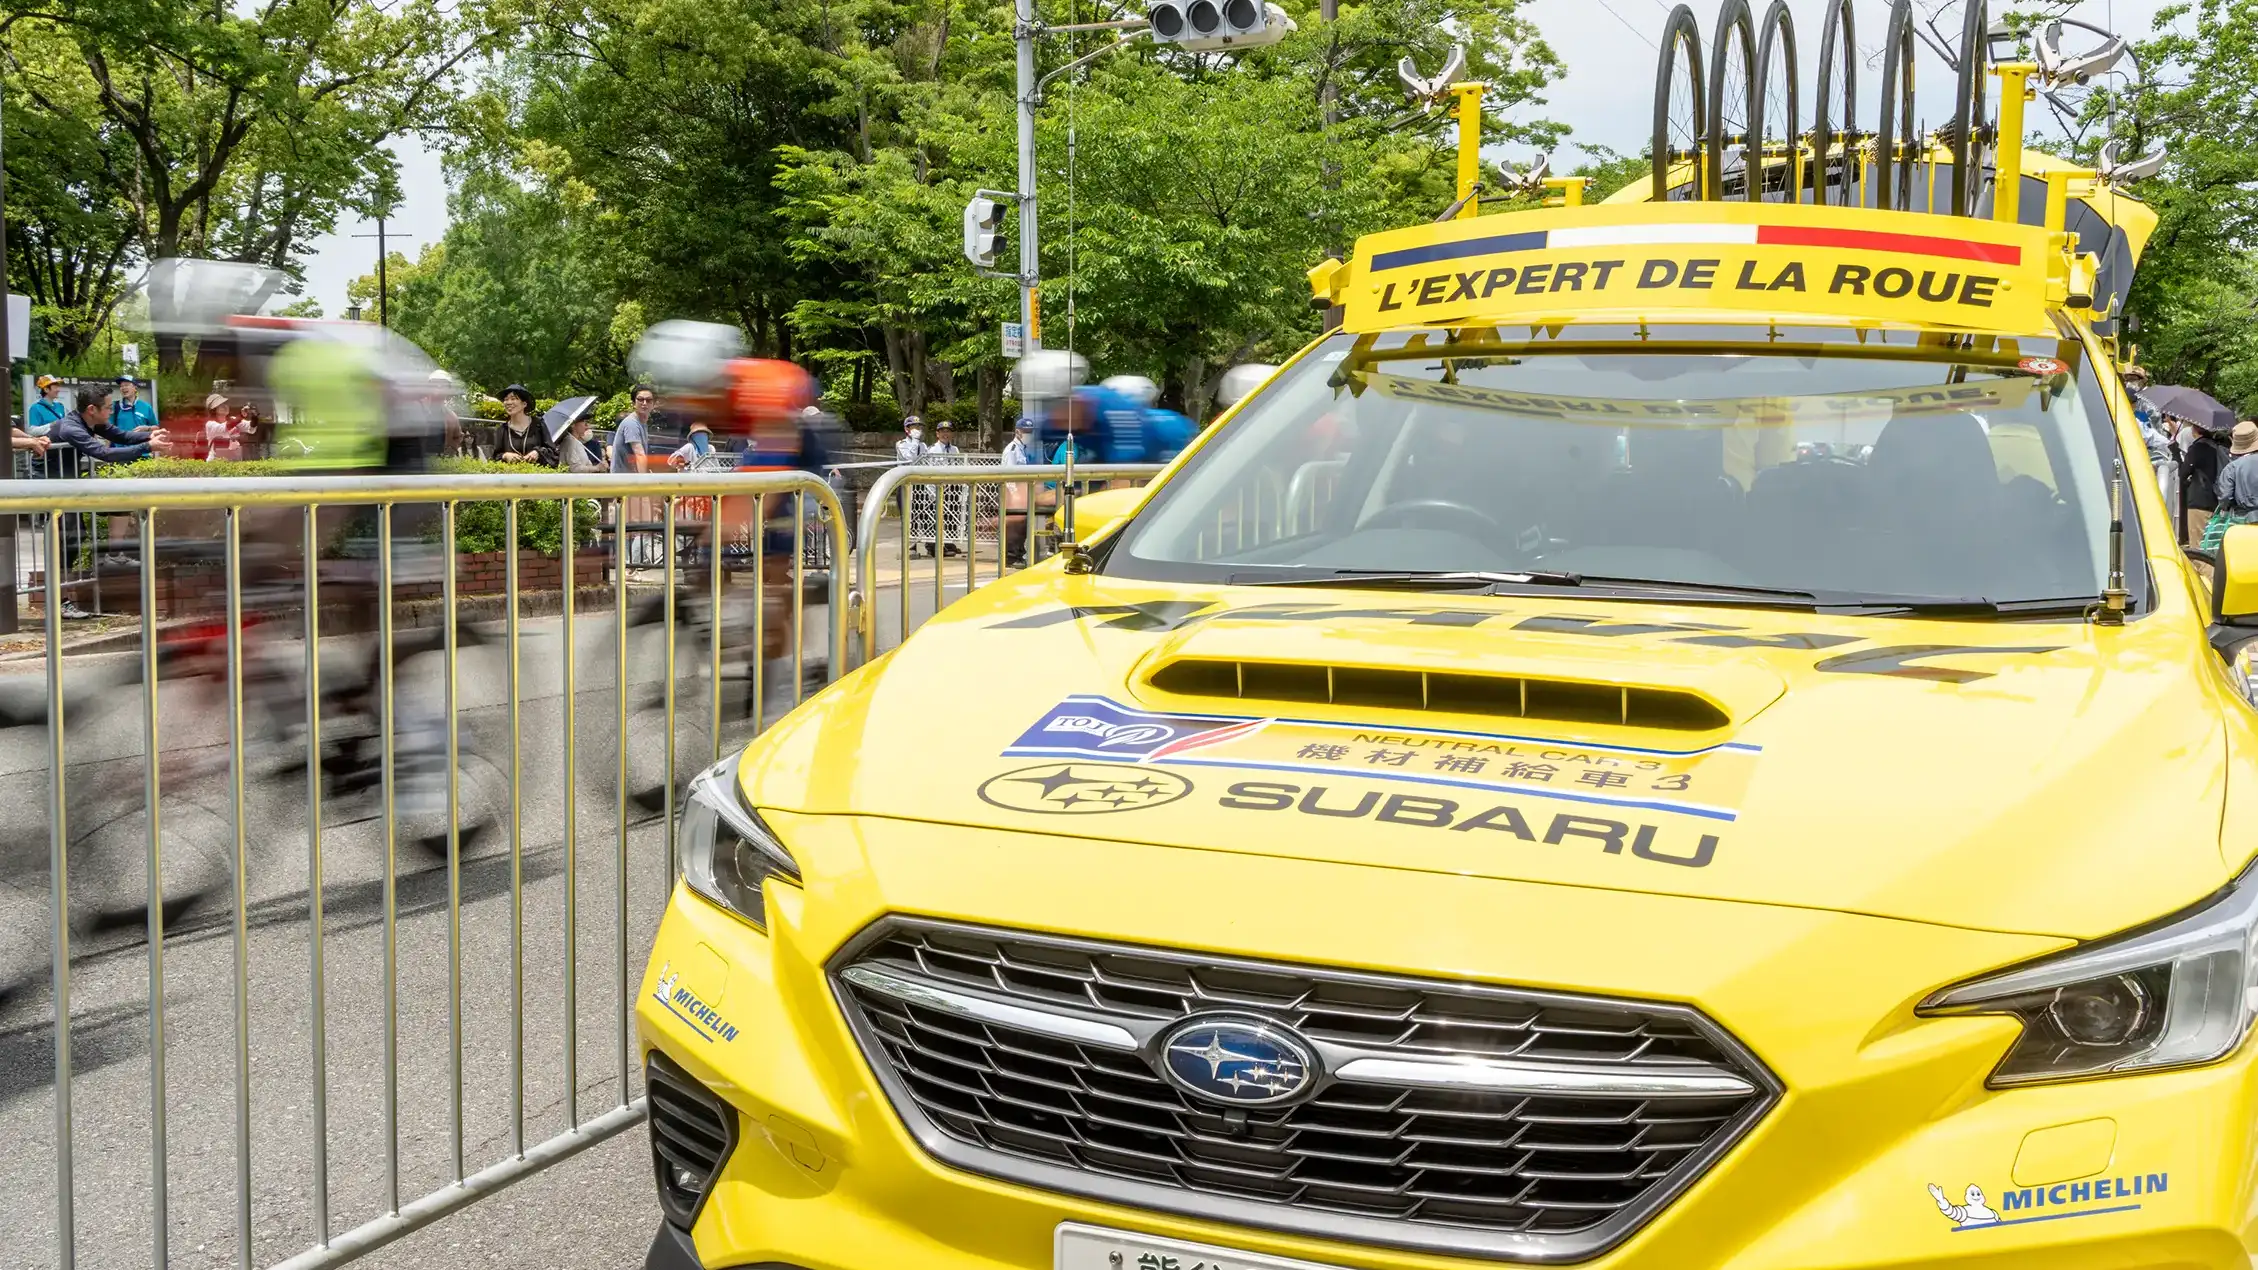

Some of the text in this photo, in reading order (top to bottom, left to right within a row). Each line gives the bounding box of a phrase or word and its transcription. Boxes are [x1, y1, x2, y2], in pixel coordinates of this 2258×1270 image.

[1378, 259, 2000, 312] L'EXPERT DE LA ROUE
[1057, 717, 1105, 730] TOJ
[1352, 733, 1662, 772] NEUTRAL CAR 3
[1219, 781, 1720, 869] SUBARU
[673, 987, 740, 1043] MICHELIN
[2002, 1172, 2168, 1211] MICHELIN
